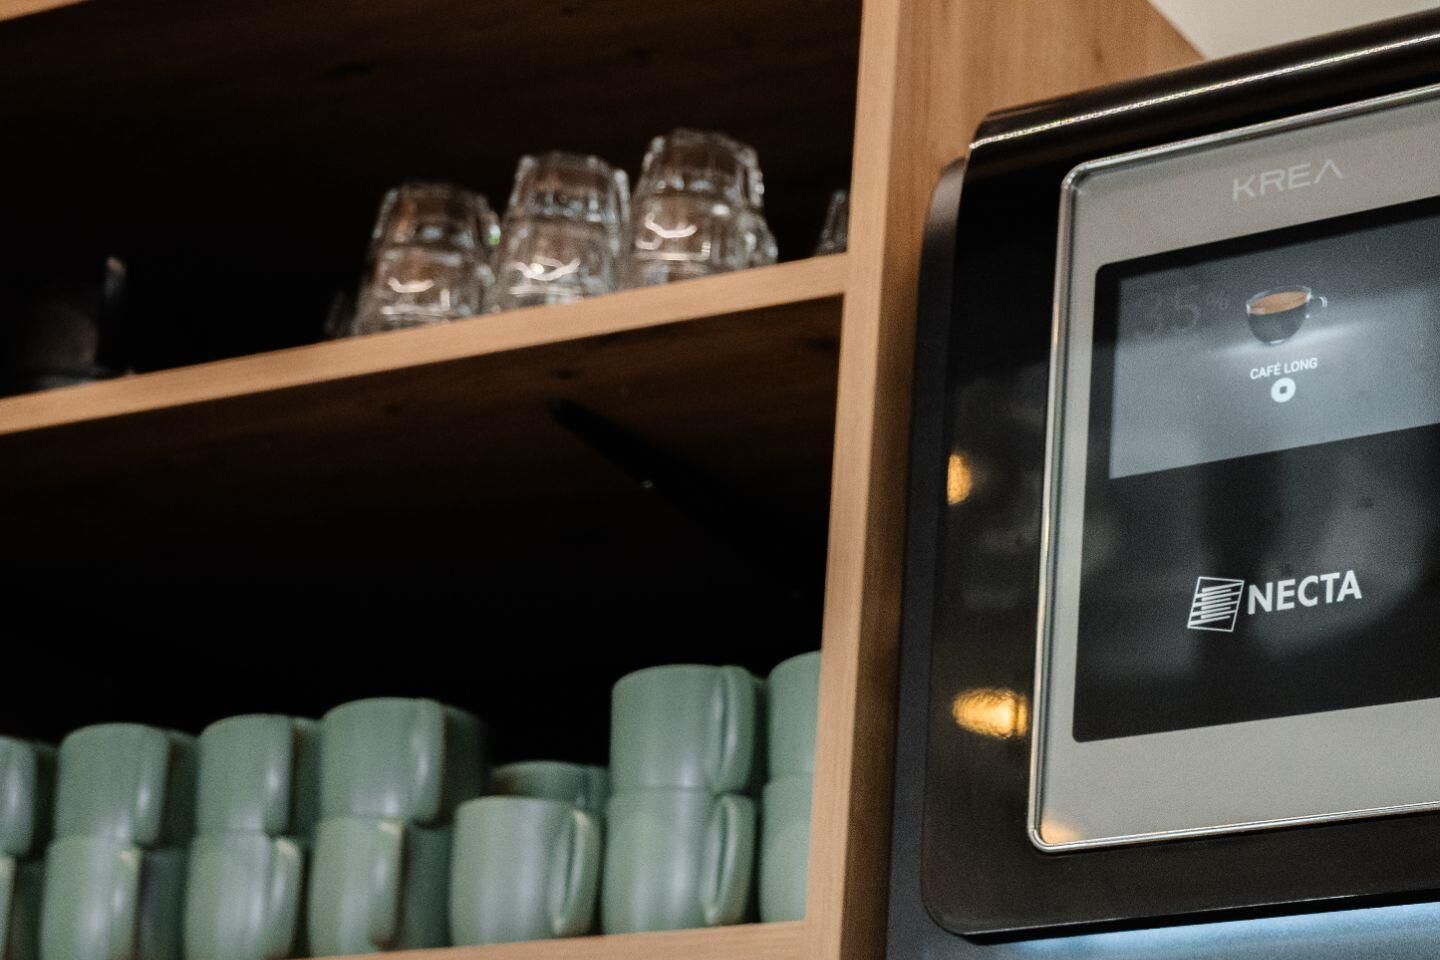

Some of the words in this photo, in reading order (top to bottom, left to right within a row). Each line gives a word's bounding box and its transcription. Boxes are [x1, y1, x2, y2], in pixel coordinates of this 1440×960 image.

[1250, 361, 1281, 380] CAFÉ
[1283, 357, 1318, 374] LONG
[1247, 570, 1363, 615] NECTA
